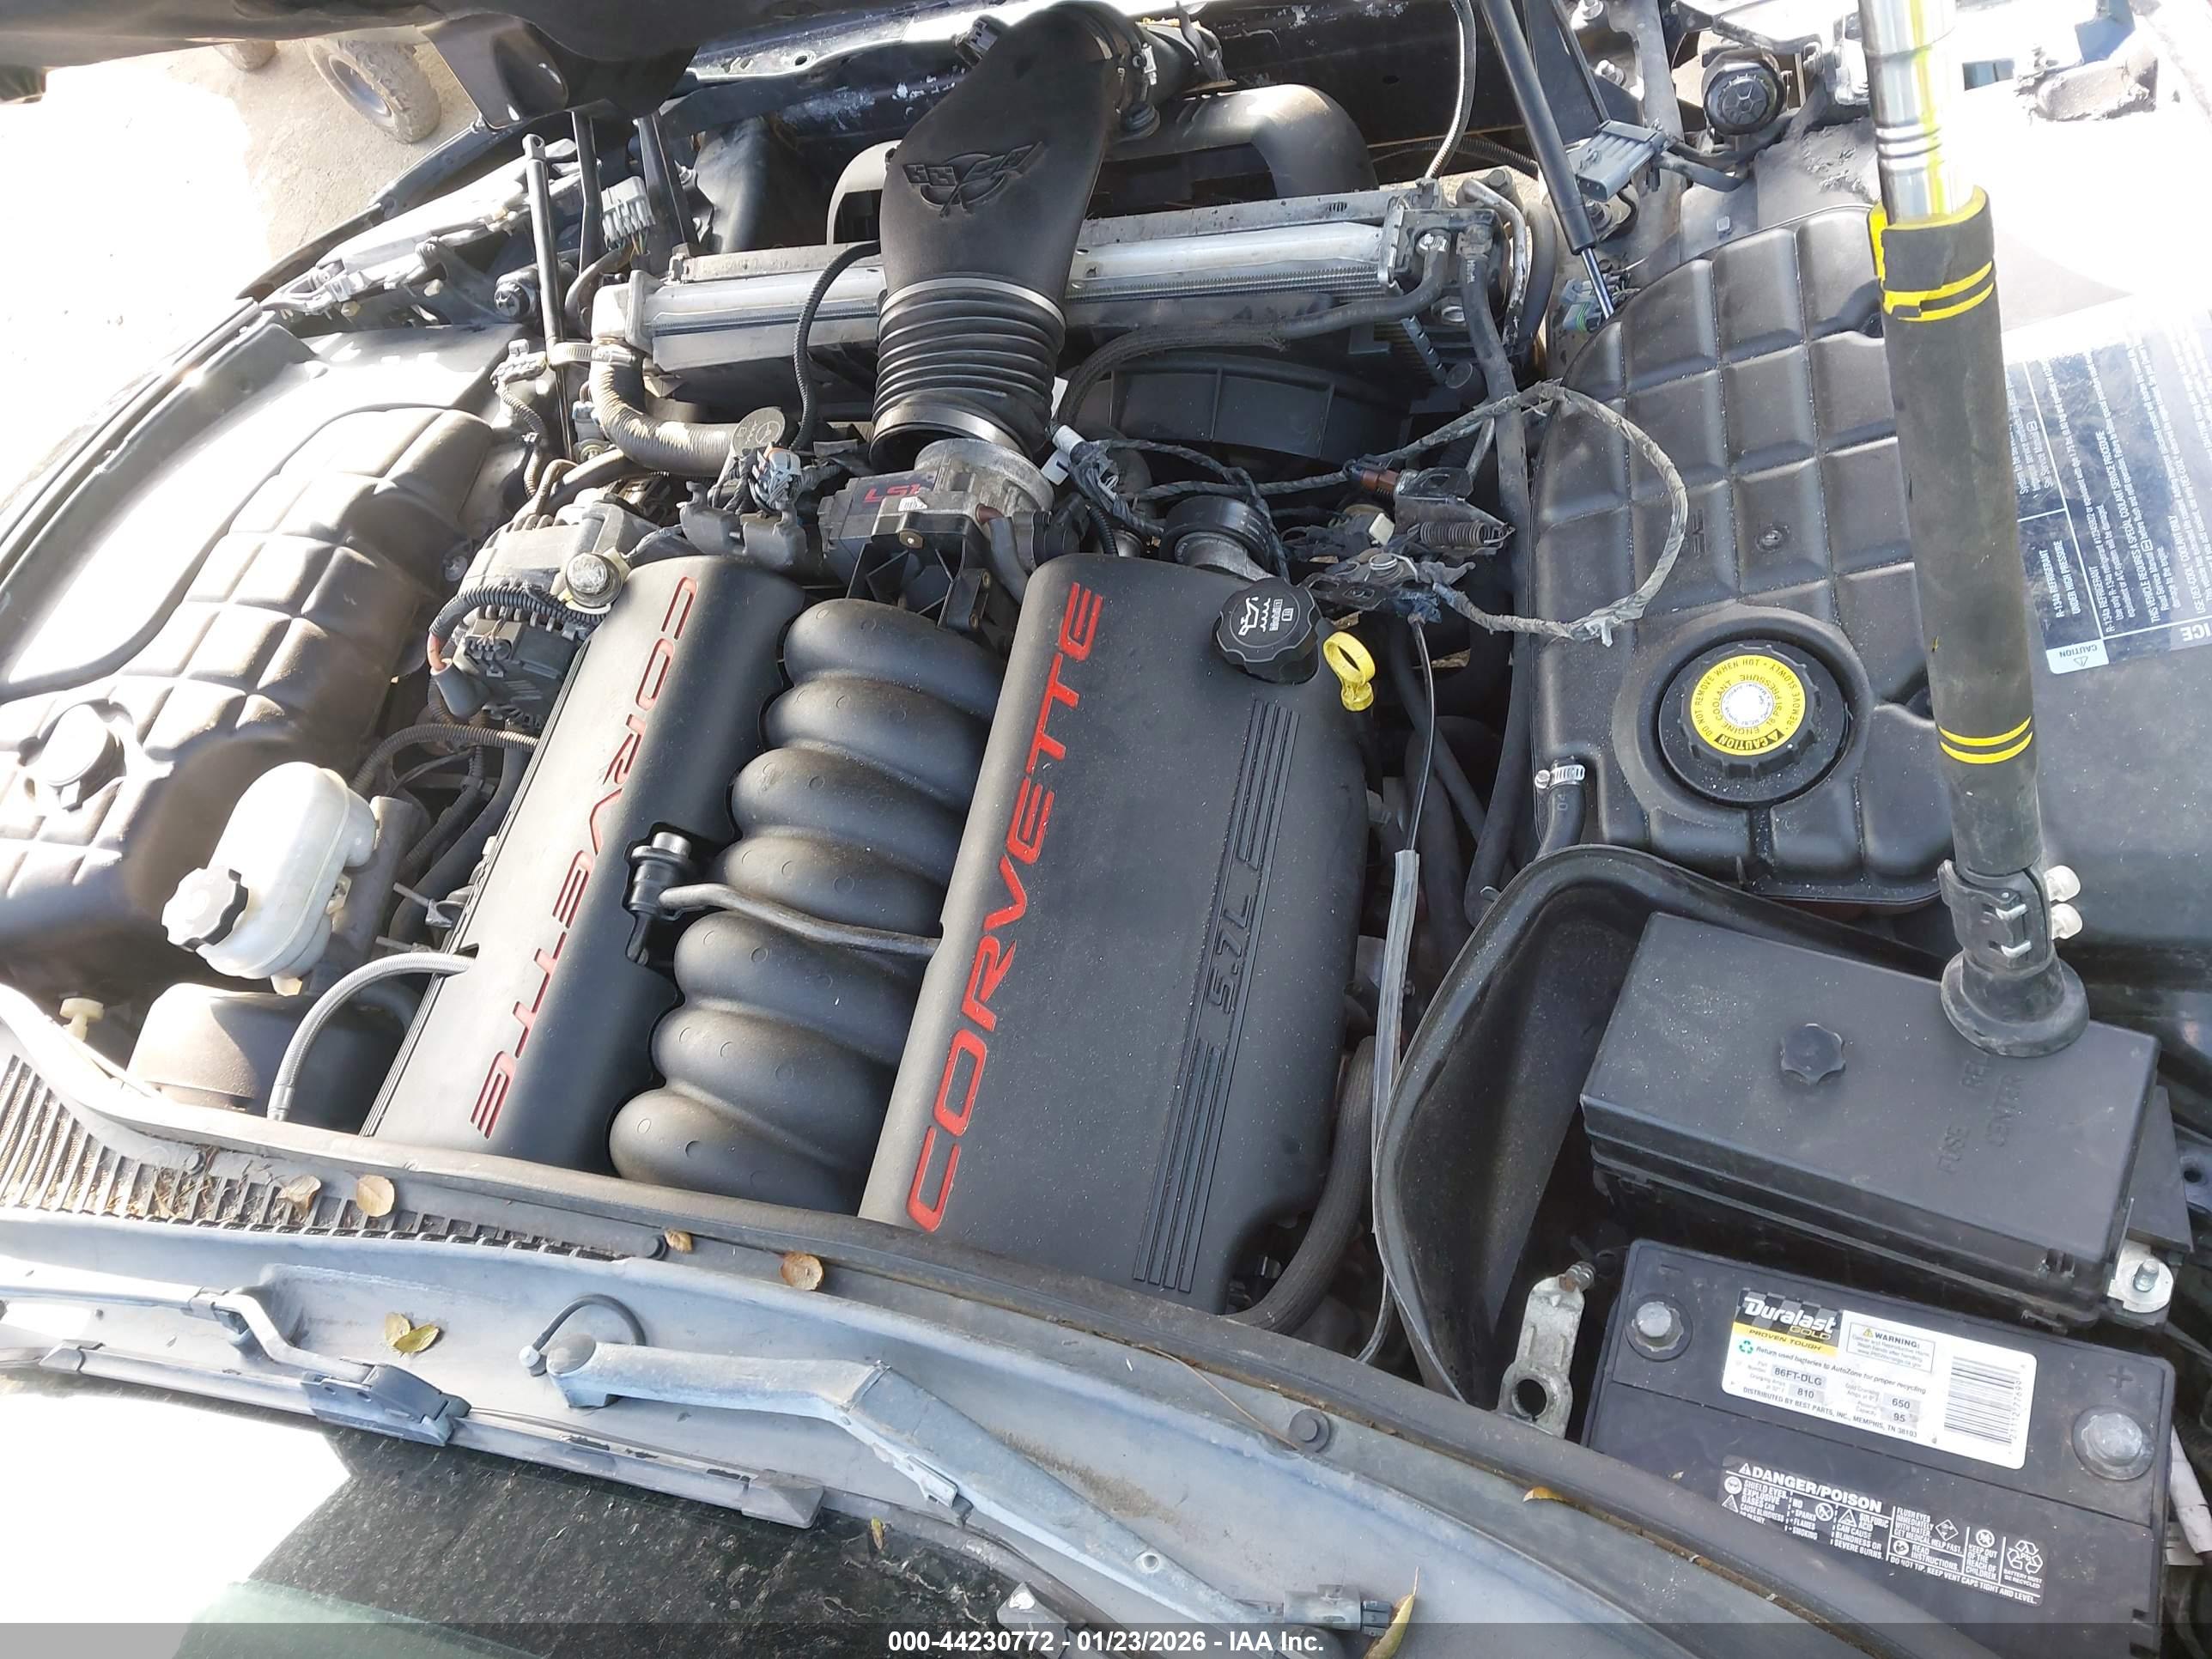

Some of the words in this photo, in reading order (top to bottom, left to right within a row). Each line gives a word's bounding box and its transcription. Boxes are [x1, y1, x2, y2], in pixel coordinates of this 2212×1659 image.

[2095, 430, 2112, 465] PROCEDURE
[2106, 464, 2120, 489] SERVICE
[2112, 489, 2129, 517] COOLANT
[2122, 517, 2136, 543] SPECIAL
[2167, 515, 2180, 532] ONLY
[2172, 532, 2190, 562] COOLANT
[2053, 540, 2069, 574] PRESSURE
[2130, 549, 2147, 580] REQUIRES
[2039, 550, 2057, 593] REFRIGERANT
[2063, 574, 2074, 591] HIGH
[2088, 566, 2107, 608] REFRIGERANT
[2067, 590, 2080, 614] UNDER
[2140, 580, 2154, 607] VEHICLE
[2051, 592, 2064, 617] R-134a
[2193, 599, 2205, 613] USE
[2101, 608, 2115, 632] R-134a
[2148, 606, 2160, 623] THIS
[2179, 623, 2212, 642] ICE
[2059, 644, 2098, 659] CAUTION
[1713, 661, 1739, 677] WHEN
[1770, 664, 1797, 690] SLOWLY
[1694, 675, 1715, 706] REMOVE
[1740, 674, 1783, 701] PRESSURE
[1712, 680, 1732, 720] COOLANT
[1773, 702, 1783, 716] PSI
[1787, 691, 1801, 726] REMOVE
[1695, 710, 1705, 725] NOT
[1702, 726, 1713, 737] DO
[1722, 721, 1759, 735] ENGINE
[1718, 734, 1769, 750] CAUTION
[470, 576, 696, 1139] CORVETTE
[907, 582, 1102, 1233] CORVETTE
[1206, 890, 1251, 1014] 5.7L
[1984, 1073, 2026, 1147] CENTER
[1936, 1124, 1971, 1175] FUSE
[1743, 1296, 1838, 1334] Duralast
[1748, 1328, 1788, 1343] PROVEN
[1790, 1339, 1822, 1352] TOUGH
[1790, 1325, 1832, 1340] GOLD
[1755, 1346, 1777, 1355] Return
[1794, 1356, 1821, 1367] batteries
[1831, 1364, 1862, 1376] AutoZone
[1873, 1376, 1895, 1385] proper
[1896, 1382, 1926, 1395] recycling
[1774, 1367, 1821, 1385] 86FT-DLG
[1796, 1388, 1814, 1398] 810
[1743, 1387, 1783, 1401] DISTRIBUTED
[1794, 1400, 1810, 1408] BEST
[1812, 1404, 1834, 1416] PARTS,
[1852, 1415, 1883, 1428] MEMPHIS,
[1898, 1427, 1917, 1437] 38103
[1892, 1398, 1910, 1408] 650
[1893, 1412, 1905, 1422] 95
[1742, 1487, 1780, 1504] EXPLOSIVE
[1743, 1480, 1767, 1492] SHIELD
[1767, 1486, 1788, 1498] EYES.
[1751, 1466, 1882, 1514] DANGER/POISON
[1741, 1494, 1763, 1507] GASES
[1764, 1502, 1775, 1510] CAN
[1792, 1498, 1802, 1508] NO
[1740, 1503, 1756, 1513] CAUSE
[1756, 1508, 1784, 1522] BLINDNESS
[1795, 1509, 1817, 1521] SPARKS
[1859, 1512, 1888, 1528] SULFURIC
[1897, 1507, 1915, 1518] FLUSH
[1793, 1517, 1815, 1529] FLAMES
[1836, 1523, 1850, 1533] CAN
[1850, 1528, 1871, 1539] CAUSE
[1857, 1522, 1873, 1531] ACID
[1894, 1521, 1910, 1531] WITH
[1911, 1526, 1930, 1537] WATER.
[1895, 1514, 1933, 1530] IMMEDIATELY
[1792, 1526, 1817, 1540] SMOKING
[1835, 1531, 1870, 1547] BLINDNESS
[1871, 1541, 1881, 1550] OR
[1905, 1531, 1929, 1545] MEDICAL
[1930, 1538, 1946, 1548] HELP
[1946, 1543, 1961, 1553] FAST.
[1834, 1539, 1858, 1552] SEVERE
[1859, 1547, 1882, 1559] BURNS.
[1911, 1544, 1929, 1554] READ
[1966, 1551, 1976, 1559] OF
[1977, 1554, 1988, 1563] THE
[1968, 1544, 1984, 1554] KEEP
[1984, 1548, 1997, 1558] OUT
[2019, 1553, 2031, 1561] Pb
[1911, 1551, 1958, 1571] INSTRUCTIONS.
[1966, 1559, 1987, 1570] REACH
[1987, 1564, 1996, 1572] OF
[1900, 1559, 1913, 1568] NOT
[1914, 1563, 1925, 1572] TIP.
[1926, 1566, 1943, 1576] KEEP
[1944, 1571, 1960, 1581] VENT
[1960, 1576, 1978, 1587] CAPS
[1979, 1582, 1998, 1592] TIGHT
[1999, 1588, 2014, 1597] AND
[2014, 1591, 2038, 1603] LEVEL.
[1965, 1566, 1996, 1580] CHILDREN.
[2003, 1569, 2027, 1578] BATTERY
[2012, 1577, 2040, 1588] RECYCLED
